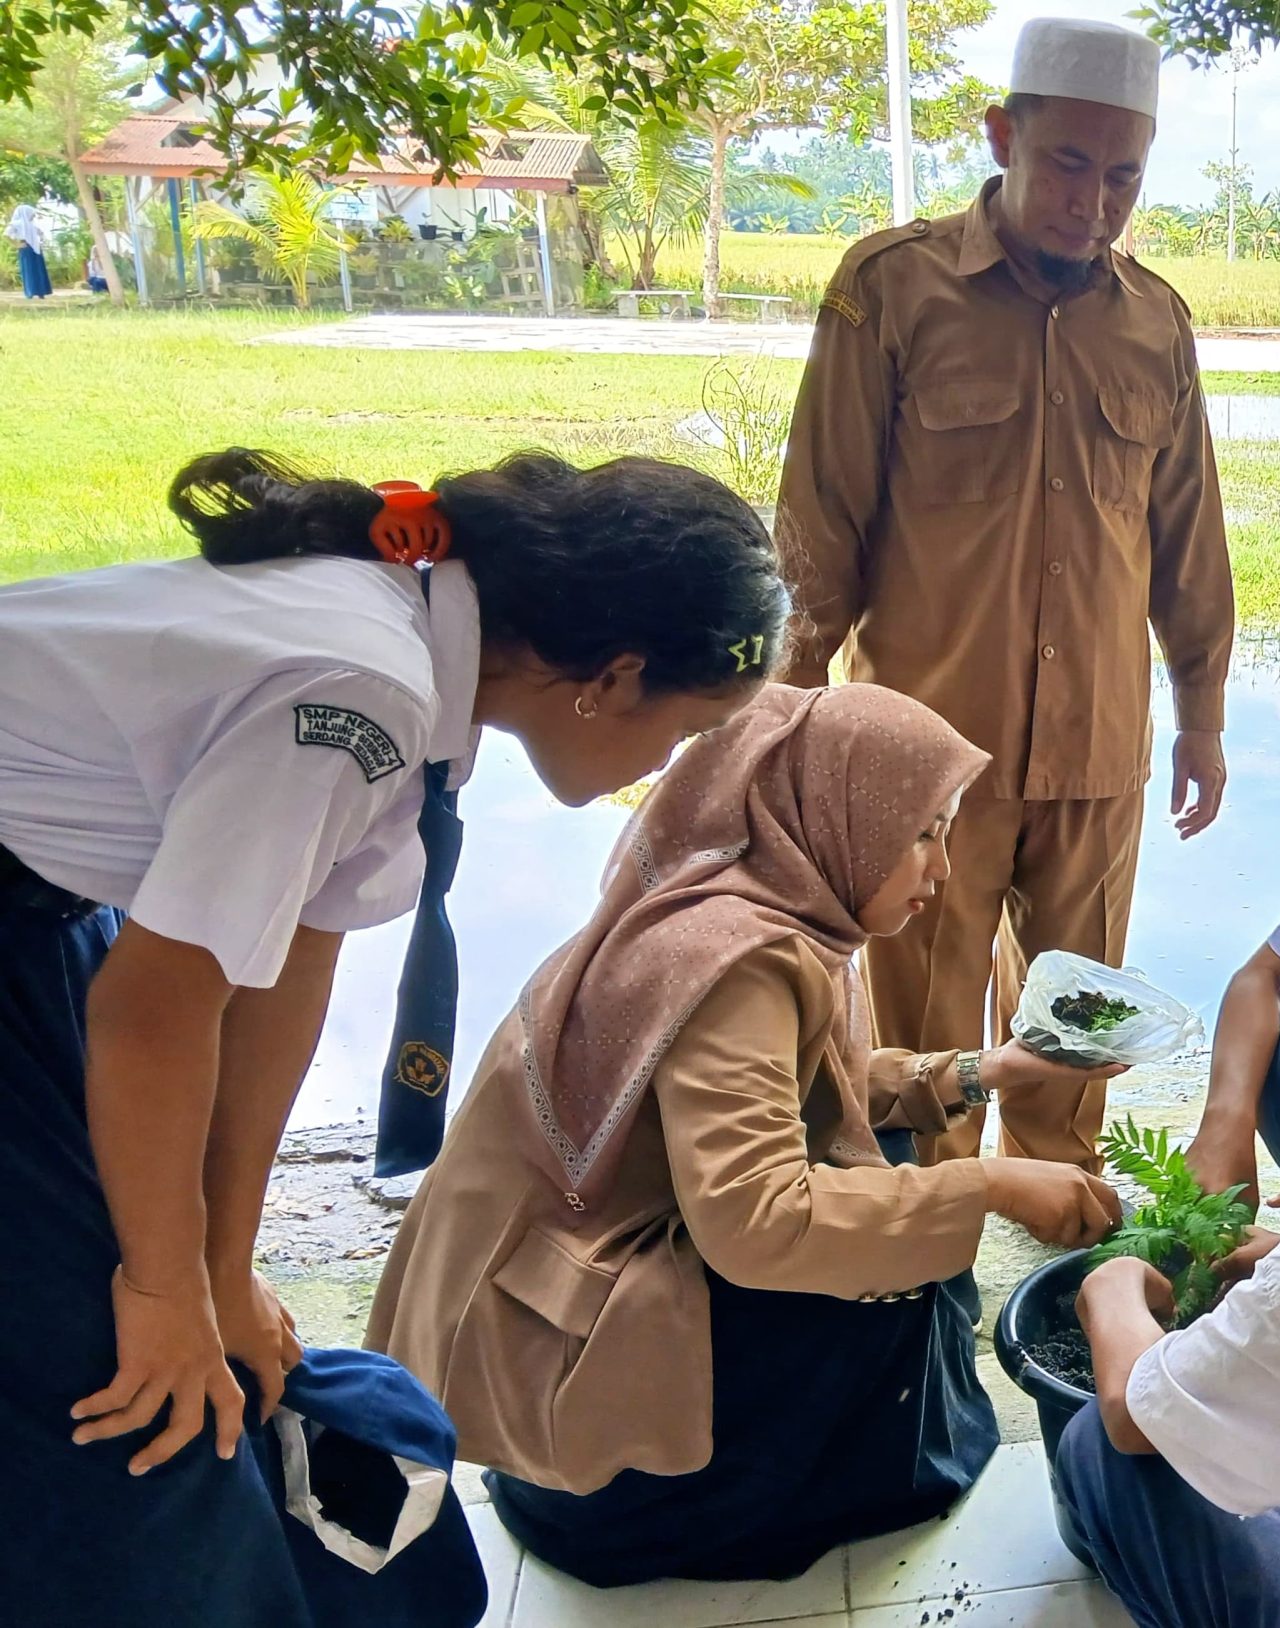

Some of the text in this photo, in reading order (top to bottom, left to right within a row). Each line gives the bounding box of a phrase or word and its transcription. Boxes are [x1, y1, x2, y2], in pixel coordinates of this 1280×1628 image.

[303, 708, 340, 721] SMP
[344, 714, 392, 756] NEGERI
[307, 720, 356, 737] TANJUNG
[303, 731, 352, 745] SERDANG
